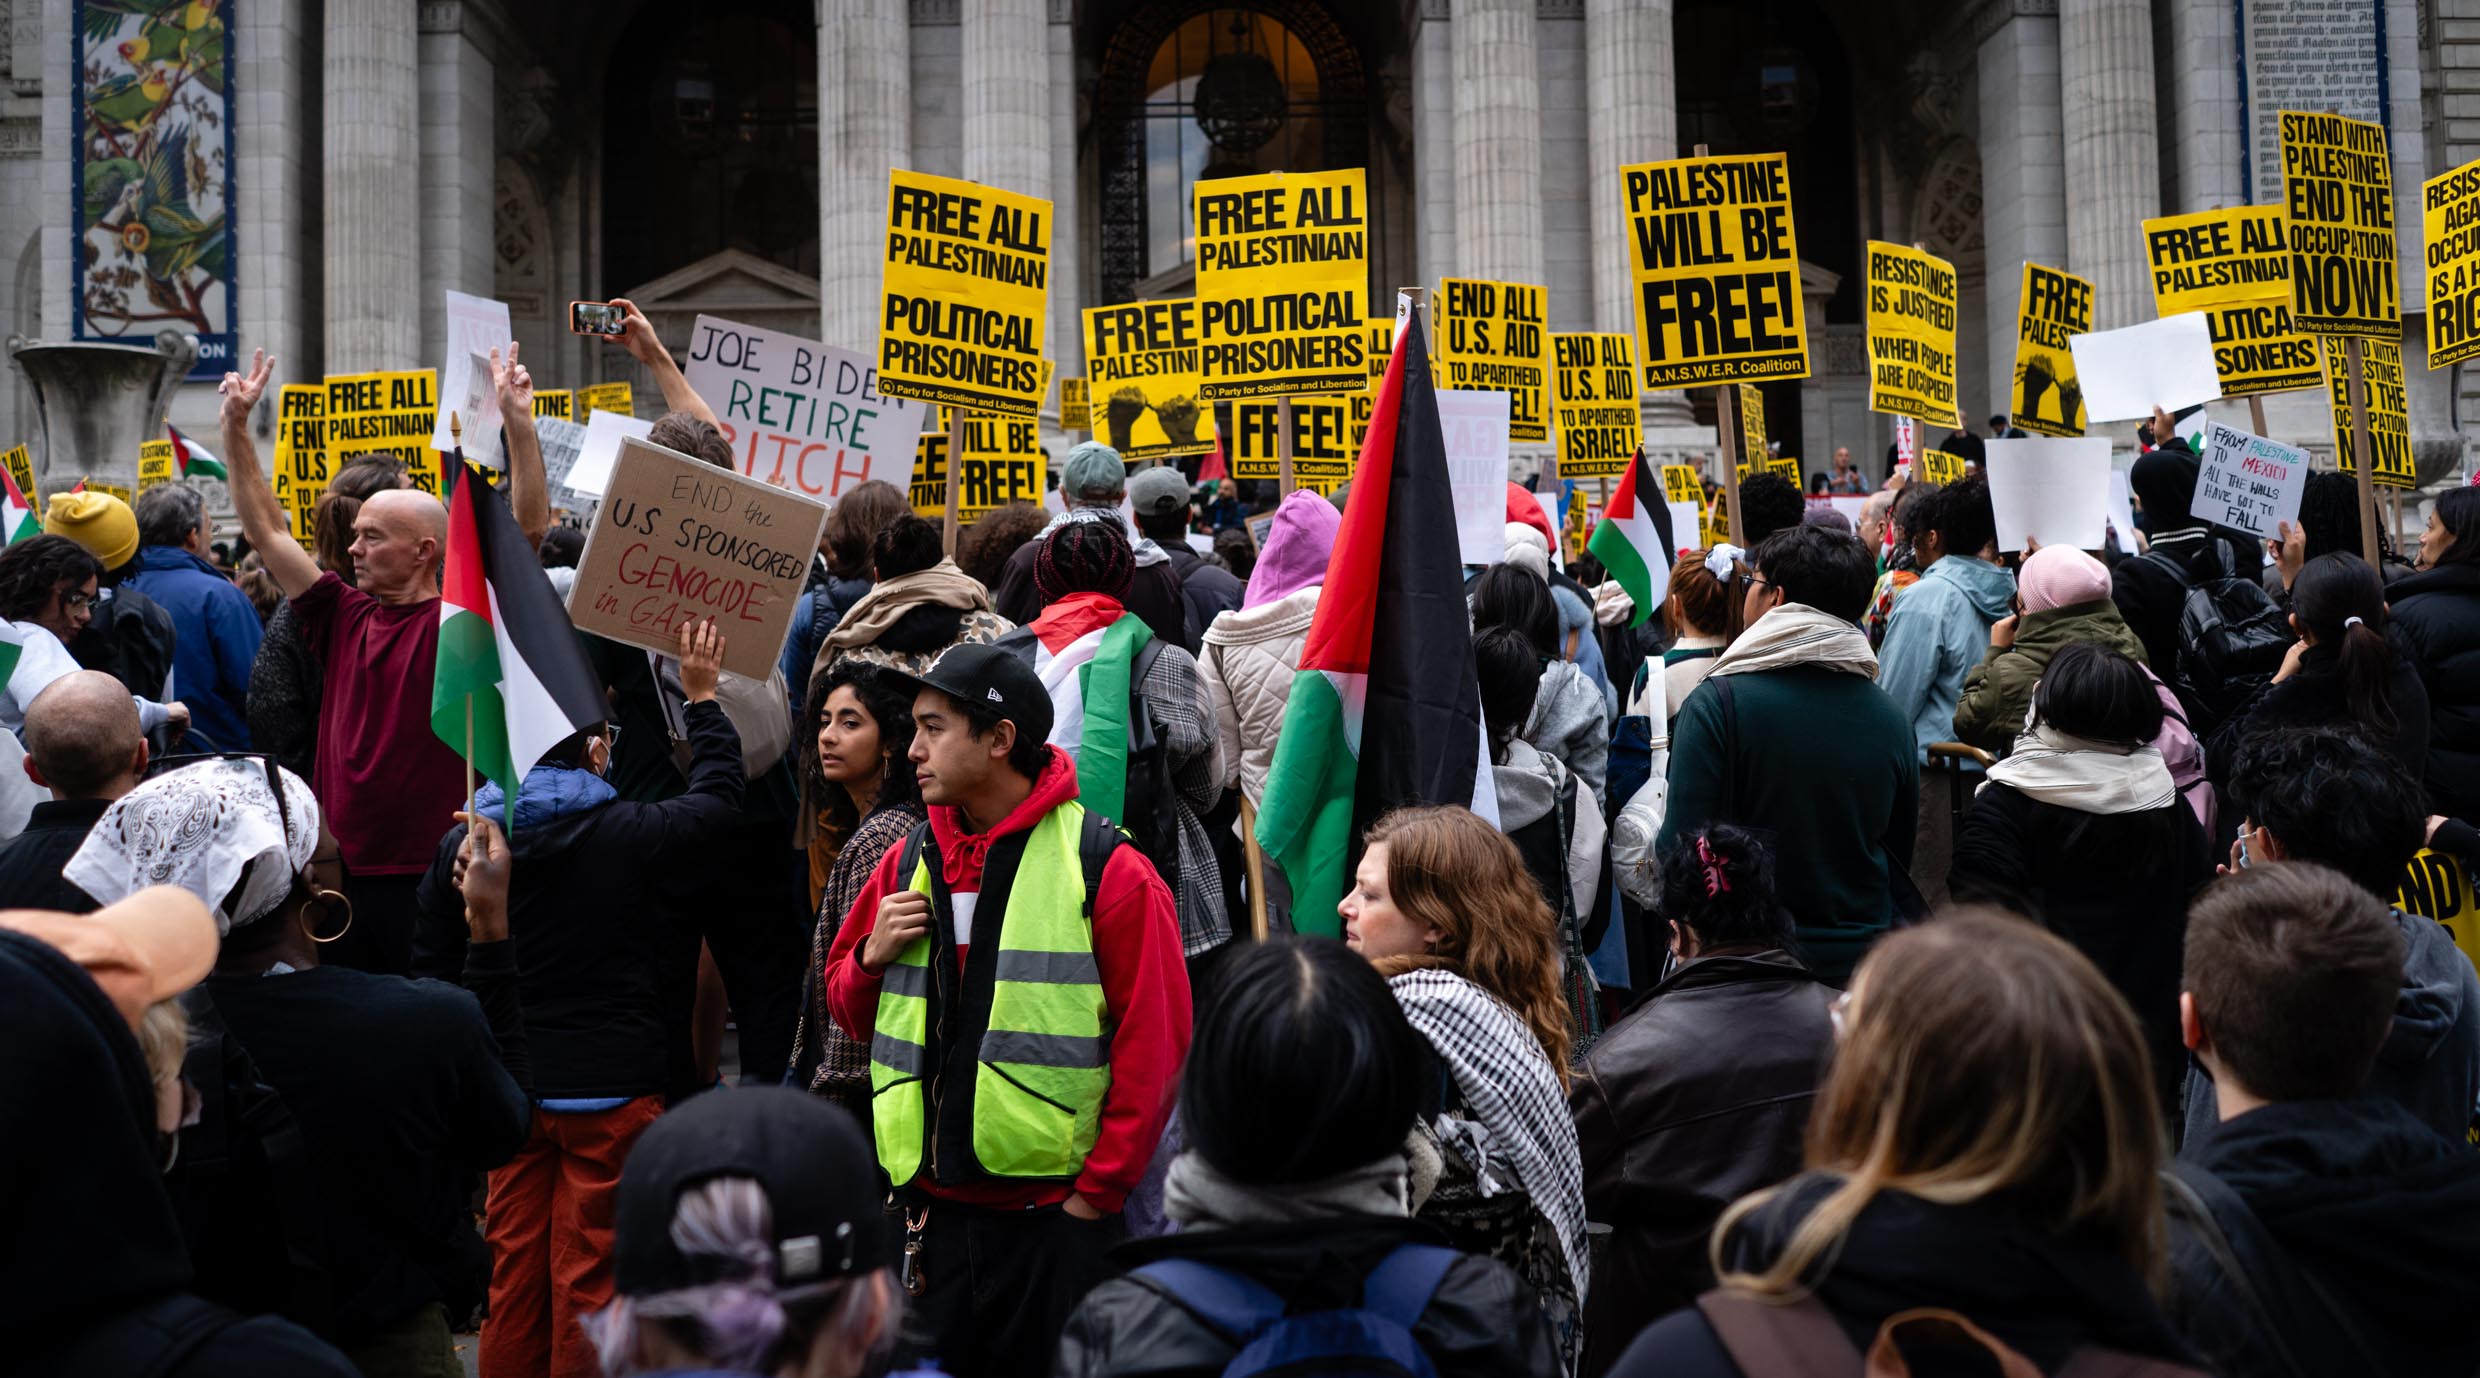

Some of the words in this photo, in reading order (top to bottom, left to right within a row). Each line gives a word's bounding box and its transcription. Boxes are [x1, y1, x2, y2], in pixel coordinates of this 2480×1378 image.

[2283, 113, 2344, 147] STAND
[2344, 122, 2384, 154] WITH
[2285, 146, 2388, 185] PALESTINE!
[1627, 160, 1787, 213] PALESTINE
[2288, 178, 2345, 222] END
[2349, 185, 2393, 229] THE
[2427, 166, 2480, 212] RESIS
[892, 185, 982, 241] FREE
[987, 204, 1047, 256] ALL
[1200, 188, 1286, 237] FREE
[1295, 185, 1363, 228] ALL
[1200, 231, 1364, 272] PALESTINIAN
[1634, 210, 1734, 270] WILL
[1740, 206, 1791, 262] BE
[2149, 221, 2234, 266] FREE
[2241, 217, 2288, 254] ALL
[2290, 225, 2393, 261] OCCUPATION
[889, 233, 1046, 290] PALESTINIAN
[1872, 285, 1889, 314] IS
[2029, 268, 2091, 332] FREE
[2293, 254, 2396, 320] NOW!
[2432, 271, 2449, 300] IS
[2453, 264, 2466, 293] A
[1202, 291, 1363, 338] POLITICAL
[1448, 282, 1496, 319] END
[1504, 286, 1542, 324] ALL
[1642, 271, 1799, 361] FREE!
[2433, 287, 2480, 350] RIG
[886, 293, 1039, 356] POLITICAL
[1093, 302, 1198, 357] FREE
[1369, 329, 1393, 354] LL
[1450, 318, 1497, 356] U.S.
[1504, 322, 1540, 359] AID
[2021, 315, 2079, 353] PALEST
[2207, 305, 2294, 344] LITICA
[2307, 322, 2323, 331] Party
[2334, 323, 2363, 332] Socialism
[2374, 325, 2400, 334] Liberation
[691, 326, 764, 373] JOE
[882, 338, 1037, 394] PRISONERS
[1090, 349, 1199, 383] PALESTIN
[1202, 334, 1364, 377] PRISONERS
[1554, 336, 1596, 368] END
[1602, 336, 1632, 368] ALL
[1872, 336, 1918, 364] WHEN
[1921, 343, 1953, 378] PEOPLE
[2214, 339, 2317, 376] SONERS
[2373, 341, 2400, 364] WITH
[1218, 386, 1242, 398] Party
[1243, 386, 1256, 395] for
[1257, 382, 1299, 394] Socialism
[1301, 380, 1319, 390] and
[1319, 378, 1366, 390] Liberation
[1448, 362, 1467, 382] TO
[1471, 362, 1542, 387] APARTHEID
[1558, 369, 1599, 402] U.S.
[1605, 369, 1633, 400] AID
[1651, 364, 1738, 383] A.N.S.W.E.R.
[1740, 357, 1801, 375] Coalition
[1877, 364, 1904, 388] ARE
[2228, 380, 2267, 393] Socialism
[2267, 379, 2282, 388] and
[2283, 375, 2322, 387] Liberation
[329, 380, 383, 414] FREE
[390, 377, 434, 409] ALL
[896, 386, 921, 398] Party
[922, 388, 935, 398] for
[936, 391, 977, 405] Socialism
[978, 398, 994, 408] and
[995, 399, 1036, 415] Liberation
[2376, 382, 2407, 414] THE
[329, 413, 435, 441] PALESTINIAN
[727, 379, 878, 451] RETIRE
[1560, 409, 1576, 427] TO
[1579, 408, 1636, 427] APARTHEID
[1008, 423, 1036, 454] BE
[1565, 427, 1636, 460] ISRAEL!
[2213, 427, 2248, 452] FROM
[2248, 440, 2300, 464] PALESTINE
[1301, 463, 1346, 474] Coalition
[1927, 452, 1948, 474] END
[2204, 464, 2221, 484] ALL
[2226, 472, 2248, 490] THE
[2249, 481, 2280, 500] WALLS
[2214, 445, 2228, 463] TO
[2242, 456, 2287, 481] MEXICO
[671, 475, 733, 514] END
[744, 501, 774, 528] the
[959, 460, 1037, 506] REE!
[2204, 483, 2232, 503] HAVE
[2237, 494, 2255, 509] GOT
[2260, 502, 2275, 517] TO
[2225, 506, 2264, 533] FALL
[613, 498, 661, 536] U.S.
[674, 518, 805, 580] SPONSORED
[594, 584, 618, 615] in
[618, 543, 769, 622] GENOCIDE
[2390, 853, 2462, 921] ND
